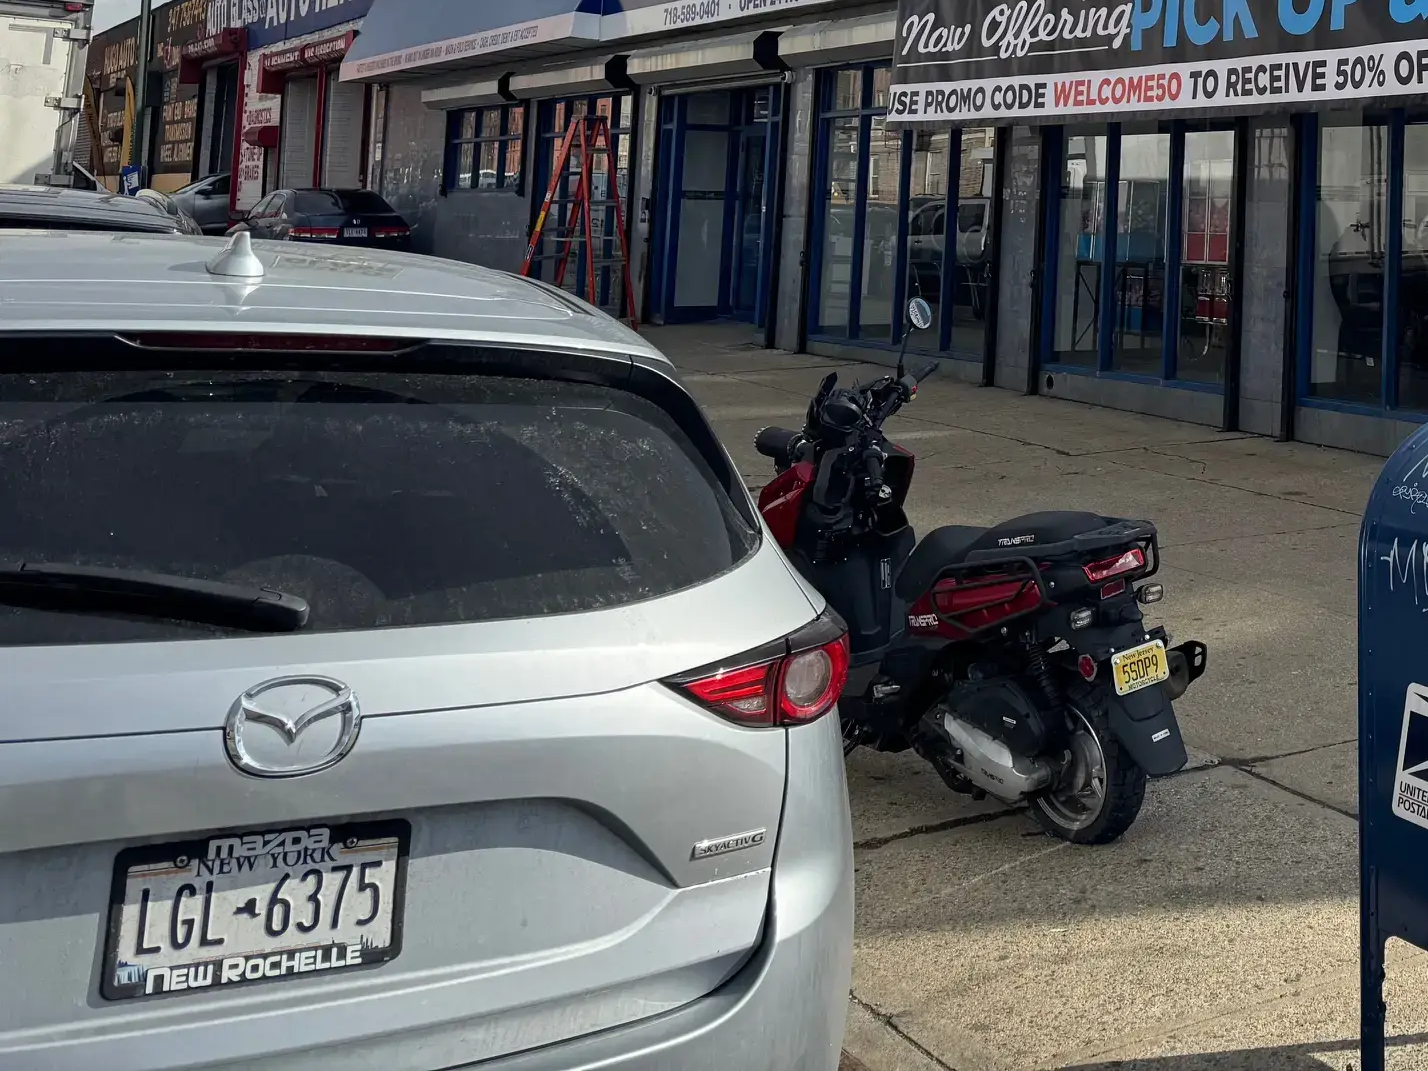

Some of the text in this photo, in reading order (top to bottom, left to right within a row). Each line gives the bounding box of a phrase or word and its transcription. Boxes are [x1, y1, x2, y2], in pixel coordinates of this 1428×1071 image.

[901, 12, 971, 56] Now
[888, 90, 920, 116] USE
[924, 86, 986, 114] PROMO
[990, 82, 1047, 111] CODE
[1053, 71, 1182, 108] WELCOME50
[1189, 69, 1219, 100] TO
[1225, 59, 1327, 97] RECEIVE
[1334, 53, 1385, 91] 50%
[1122, 646, 1154, 662] New Jersey
[196, 842, 340, 877] NEW YORK
[135, 860, 384, 956] LGL 6375
[221, 943, 362, 984] ROCHELLE
